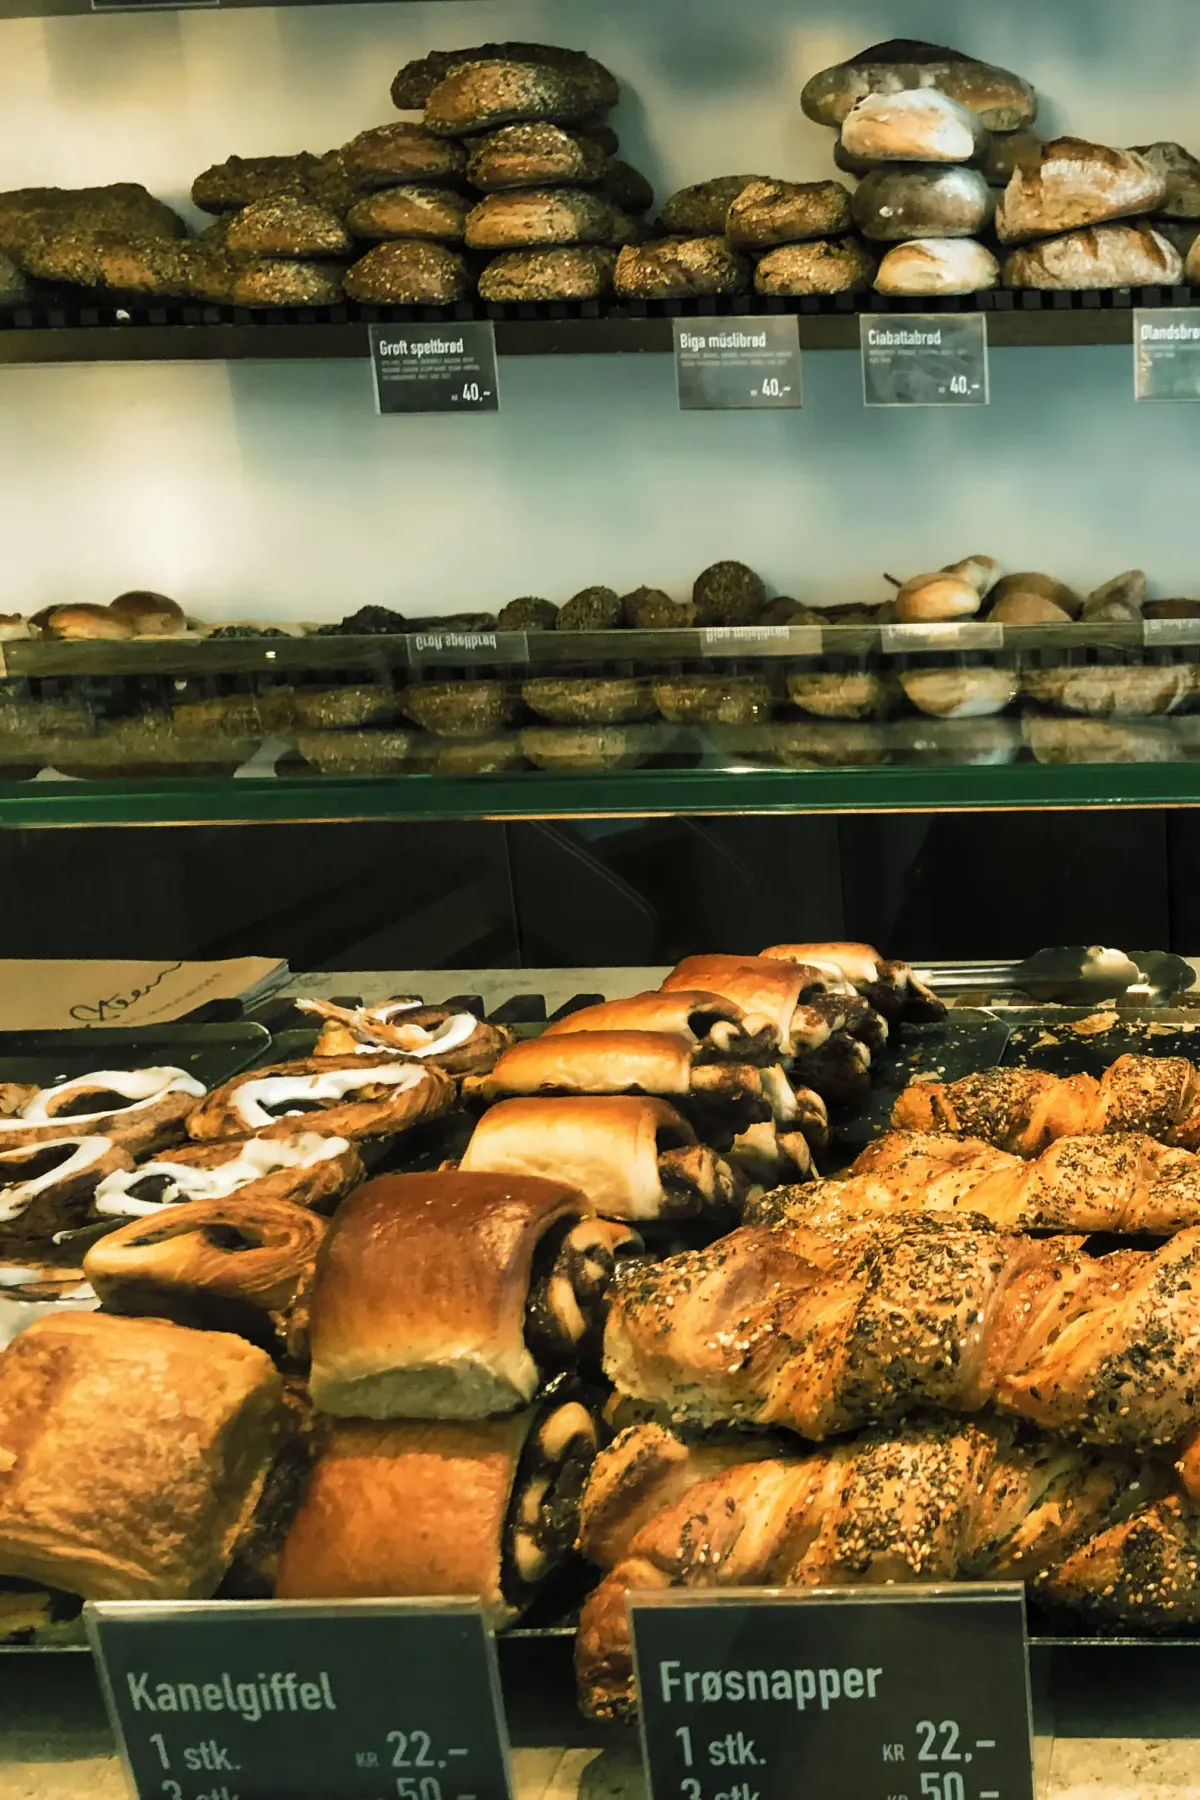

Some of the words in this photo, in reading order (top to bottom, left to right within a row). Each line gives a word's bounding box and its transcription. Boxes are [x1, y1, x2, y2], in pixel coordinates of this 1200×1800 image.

[680, 332, 706, 352] Biga
[708, 331, 766, 348] müslibrød
[868, 328, 942, 345] Ciabattabrød
[379, 339, 408, 356] Groft
[410, 337, 464, 358] speltbrød
[462, 382, 491, 402] 40,-
[762, 377, 791, 398] 40,-
[949, 374, 980, 396] 40,-
[659, 1660, 883, 1710] Frøsnapper
[126, 1670, 338, 1722] Kanelgiffel
[149, 1732, 171, 1770] 1
[183, 1739, 241, 1770] stk.
[355, 1751, 380, 1768] KR
[675, 1725, 694, 1767] 1
[708, 1730, 767, 1766] stk.
[882, 1743, 906, 1762] KR
[915, 1719, 996, 1763] 22,-
